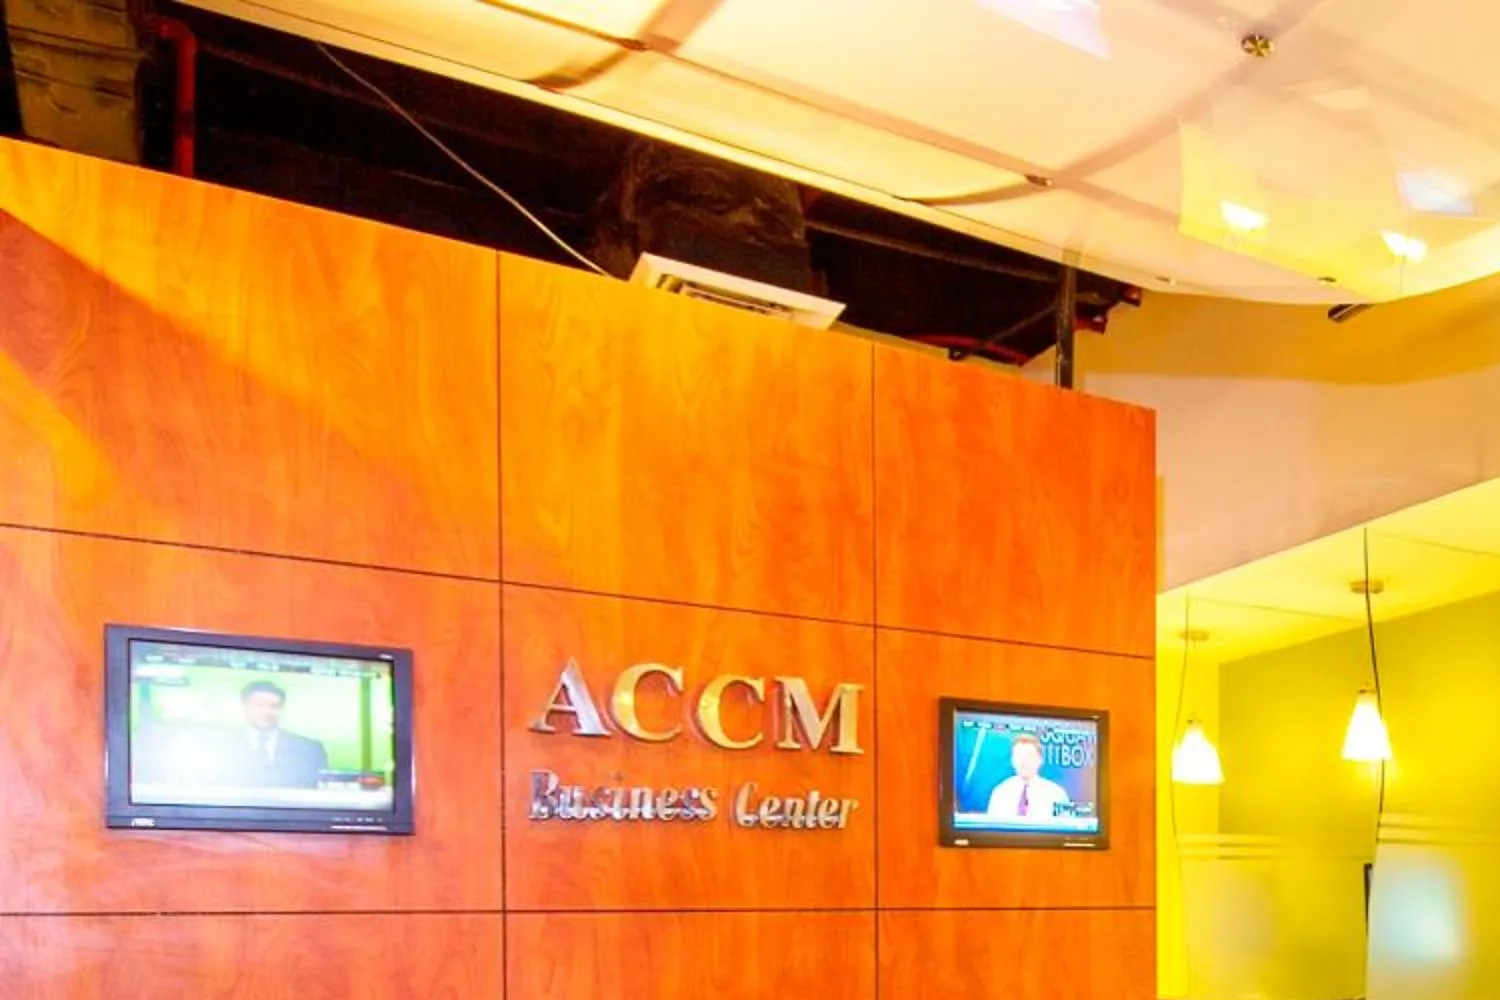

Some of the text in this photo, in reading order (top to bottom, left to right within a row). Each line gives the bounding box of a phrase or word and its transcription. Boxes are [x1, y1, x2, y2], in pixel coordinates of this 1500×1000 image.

[528, 656, 865, 754] ACCM
[528, 769, 858, 829] Business Center
